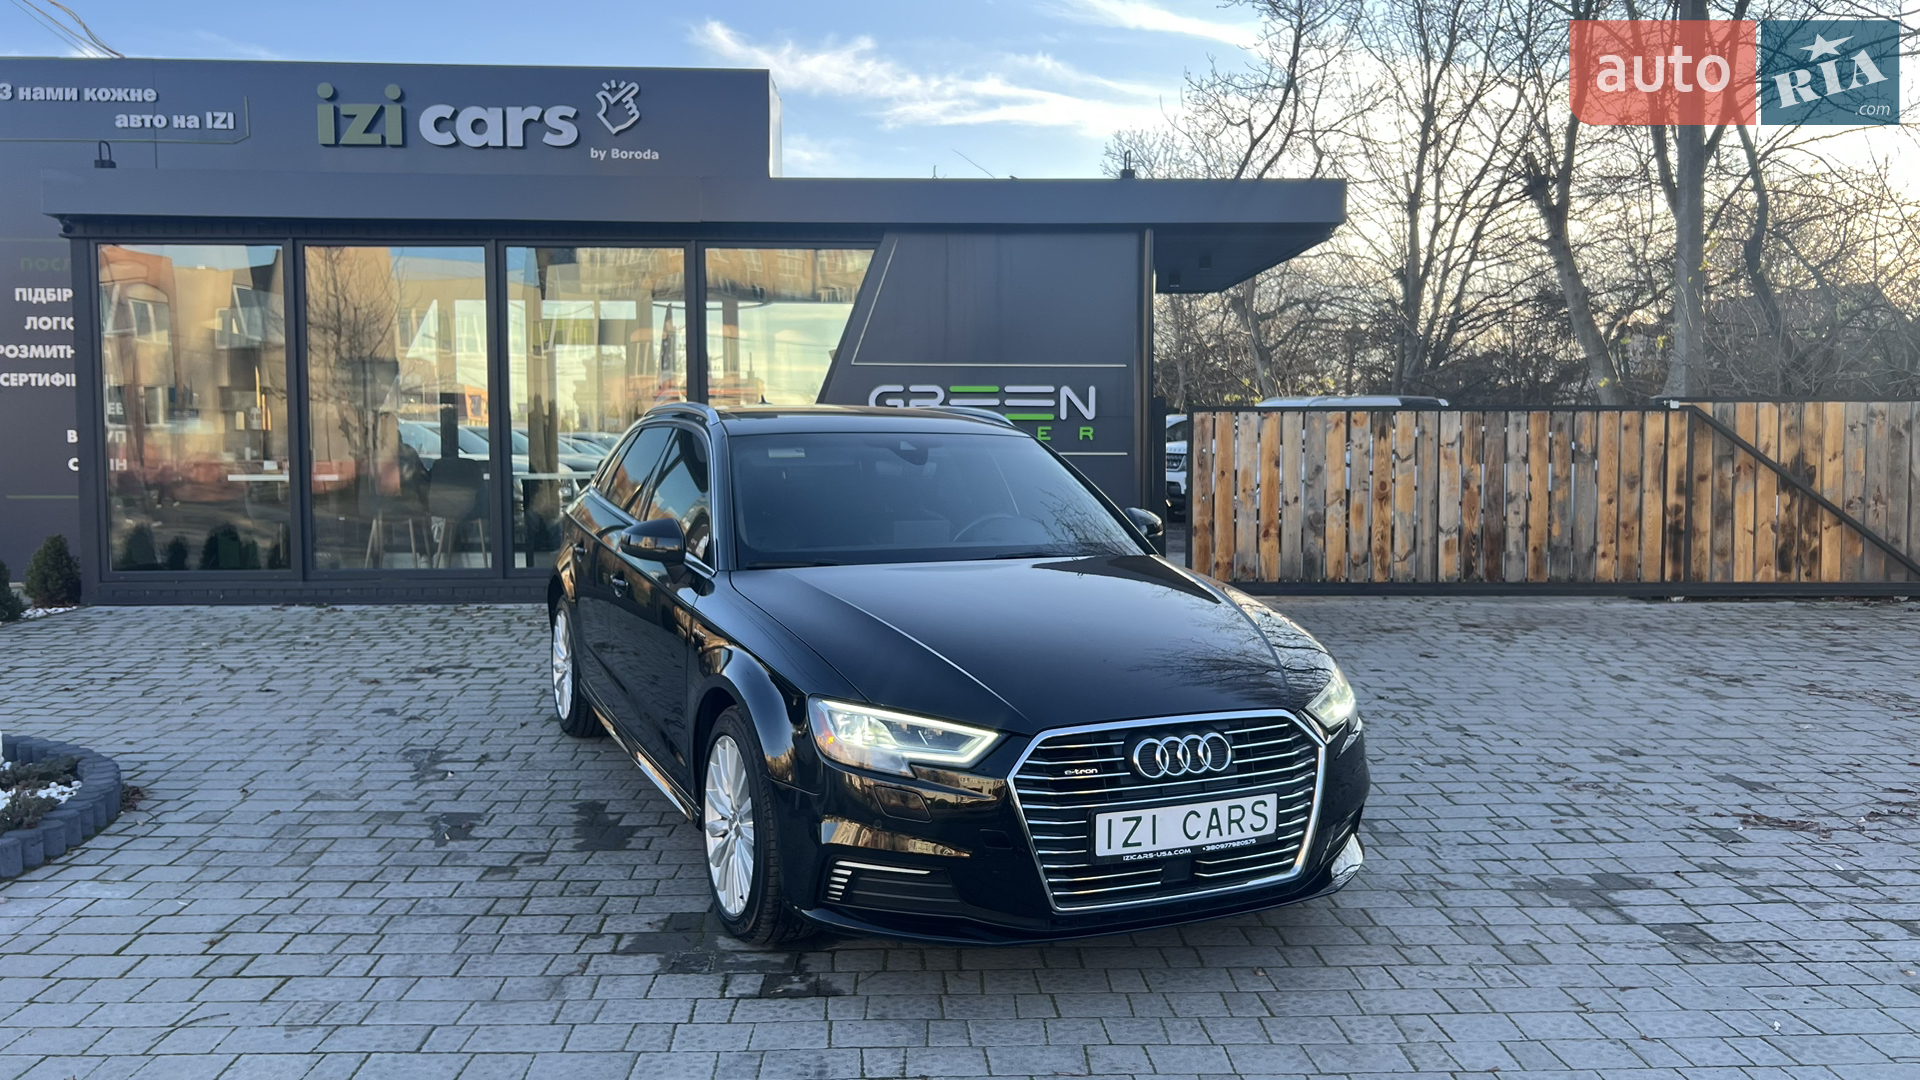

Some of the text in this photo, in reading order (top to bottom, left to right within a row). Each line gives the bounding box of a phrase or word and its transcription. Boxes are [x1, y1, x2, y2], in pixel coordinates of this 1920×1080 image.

[18, 86, 78, 102] нами
[84, 87, 158, 103] кожне
[115, 111, 236, 130] авто на IZI
[317, 82, 580, 148] izi cars
[590, 148, 660, 161] by Boroda
[868, 384, 1097, 421] GREEN
[1064, 768, 1099, 776] e-tron
[1107, 799, 1269, 850] IZI CARS
